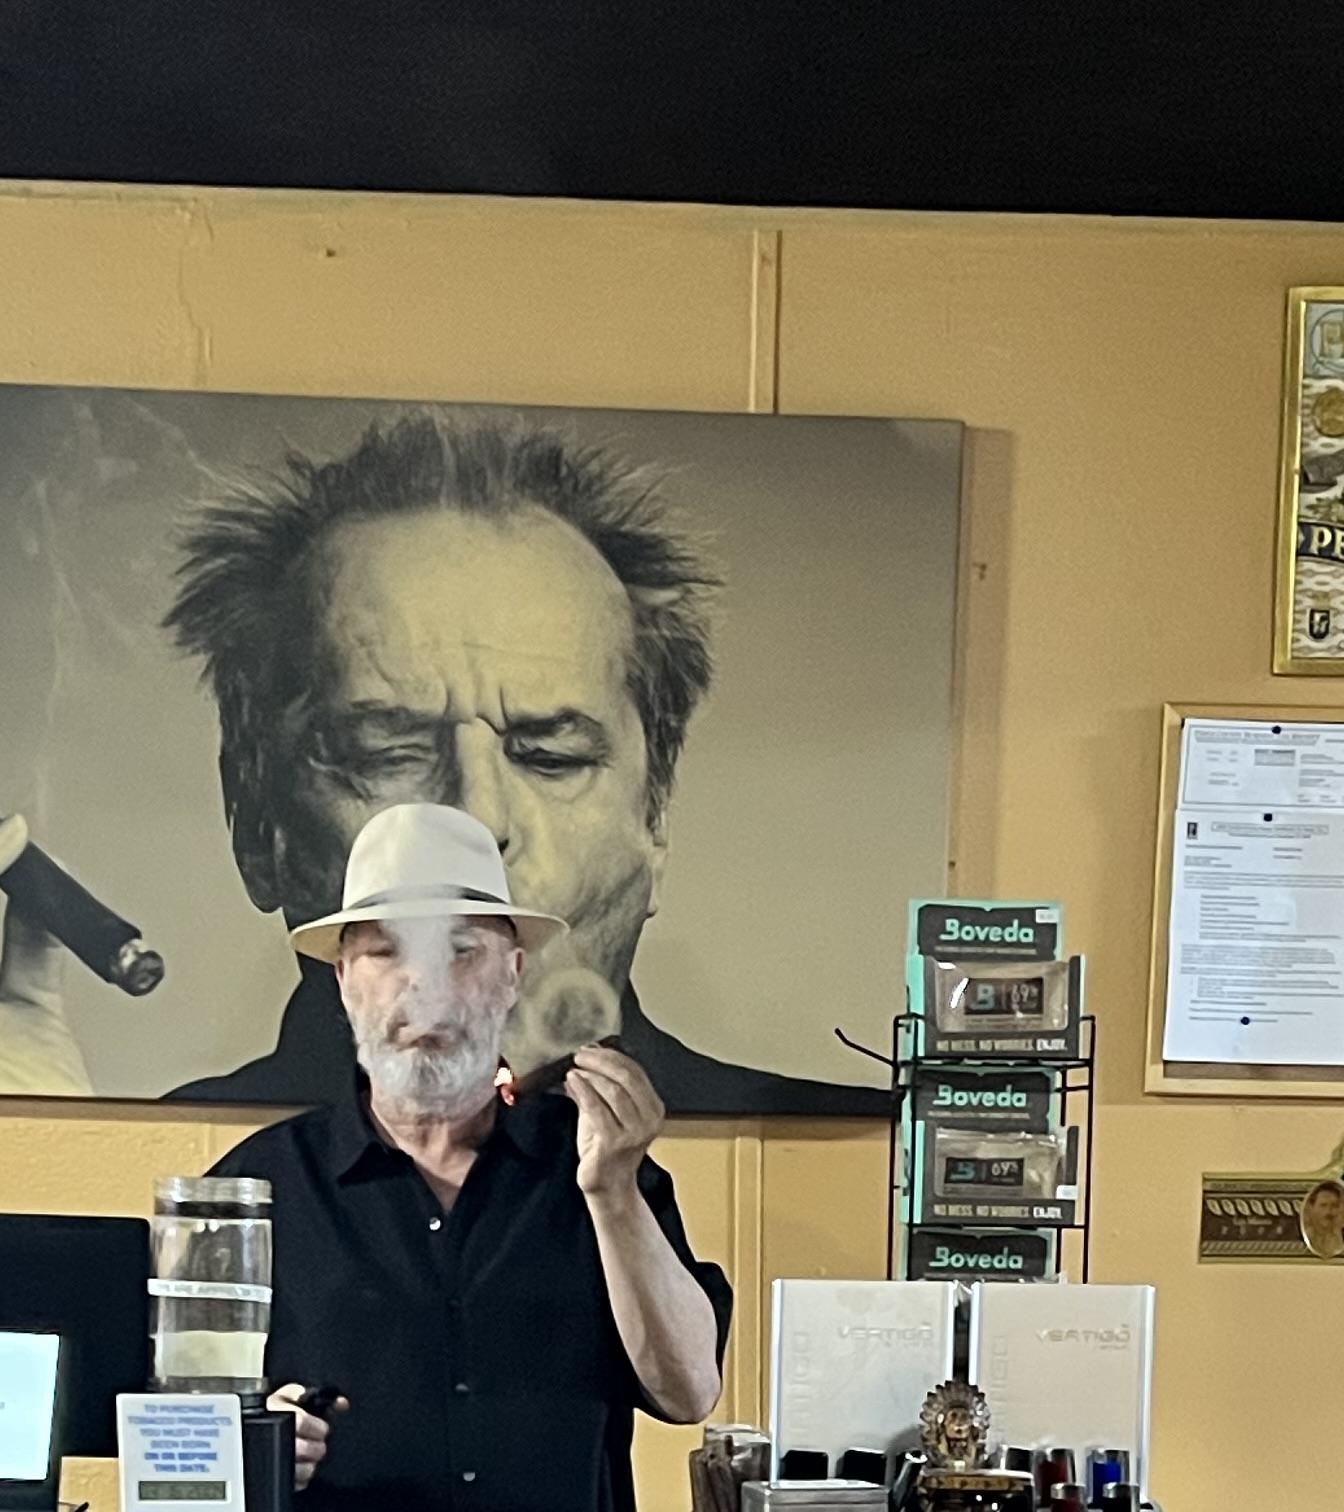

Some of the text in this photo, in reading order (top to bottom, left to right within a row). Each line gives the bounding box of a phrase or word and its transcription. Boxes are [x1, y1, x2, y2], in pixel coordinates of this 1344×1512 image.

[939, 918, 1034, 943] Boveda
[937, 1039, 950, 1051] NO
[979, 1039, 992, 1051] NO
[932, 1084, 1027, 1108] Boveda
[934, 1204, 946, 1216] NO
[976, 1205, 989, 1217] NO
[929, 1246, 1023, 1270] Boveda
[838, 1322, 935, 1341] VERTIGO
[1036, 1324, 1131, 1343] VERTIGO
[159, 1404, 214, 1414] PURCHASE
[128, 1416, 233, 1425] TOBACCO PRODUCTS
[140, 1428, 219, 1437] YOU MUST HAVE
[181, 1440, 211, 1449] BORN
[144, 1452, 217, 1461] ON OR BEFORE
[154, 1463, 177, 1472] THIS
